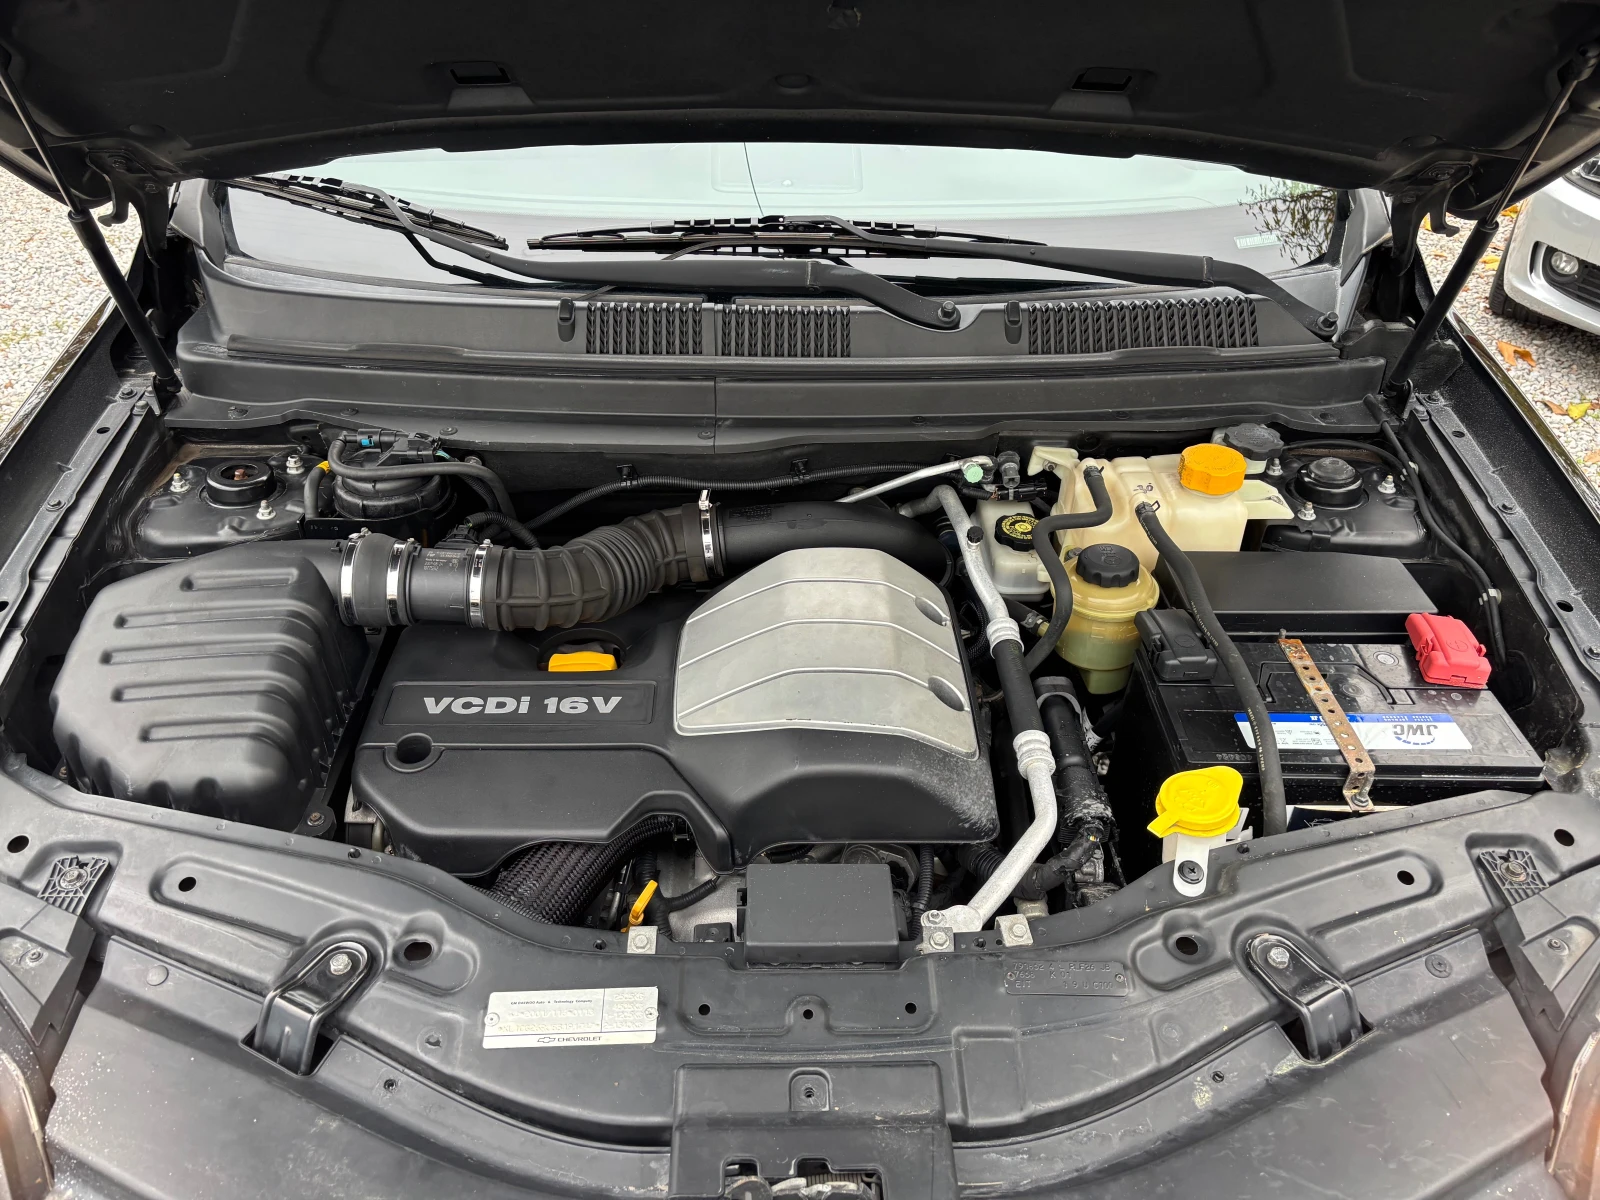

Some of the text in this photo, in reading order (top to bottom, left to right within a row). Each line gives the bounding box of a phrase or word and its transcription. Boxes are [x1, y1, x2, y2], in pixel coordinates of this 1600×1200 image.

[424, 696, 622, 714] VCDi 16V
[1392, 724, 1438, 737] JWC
